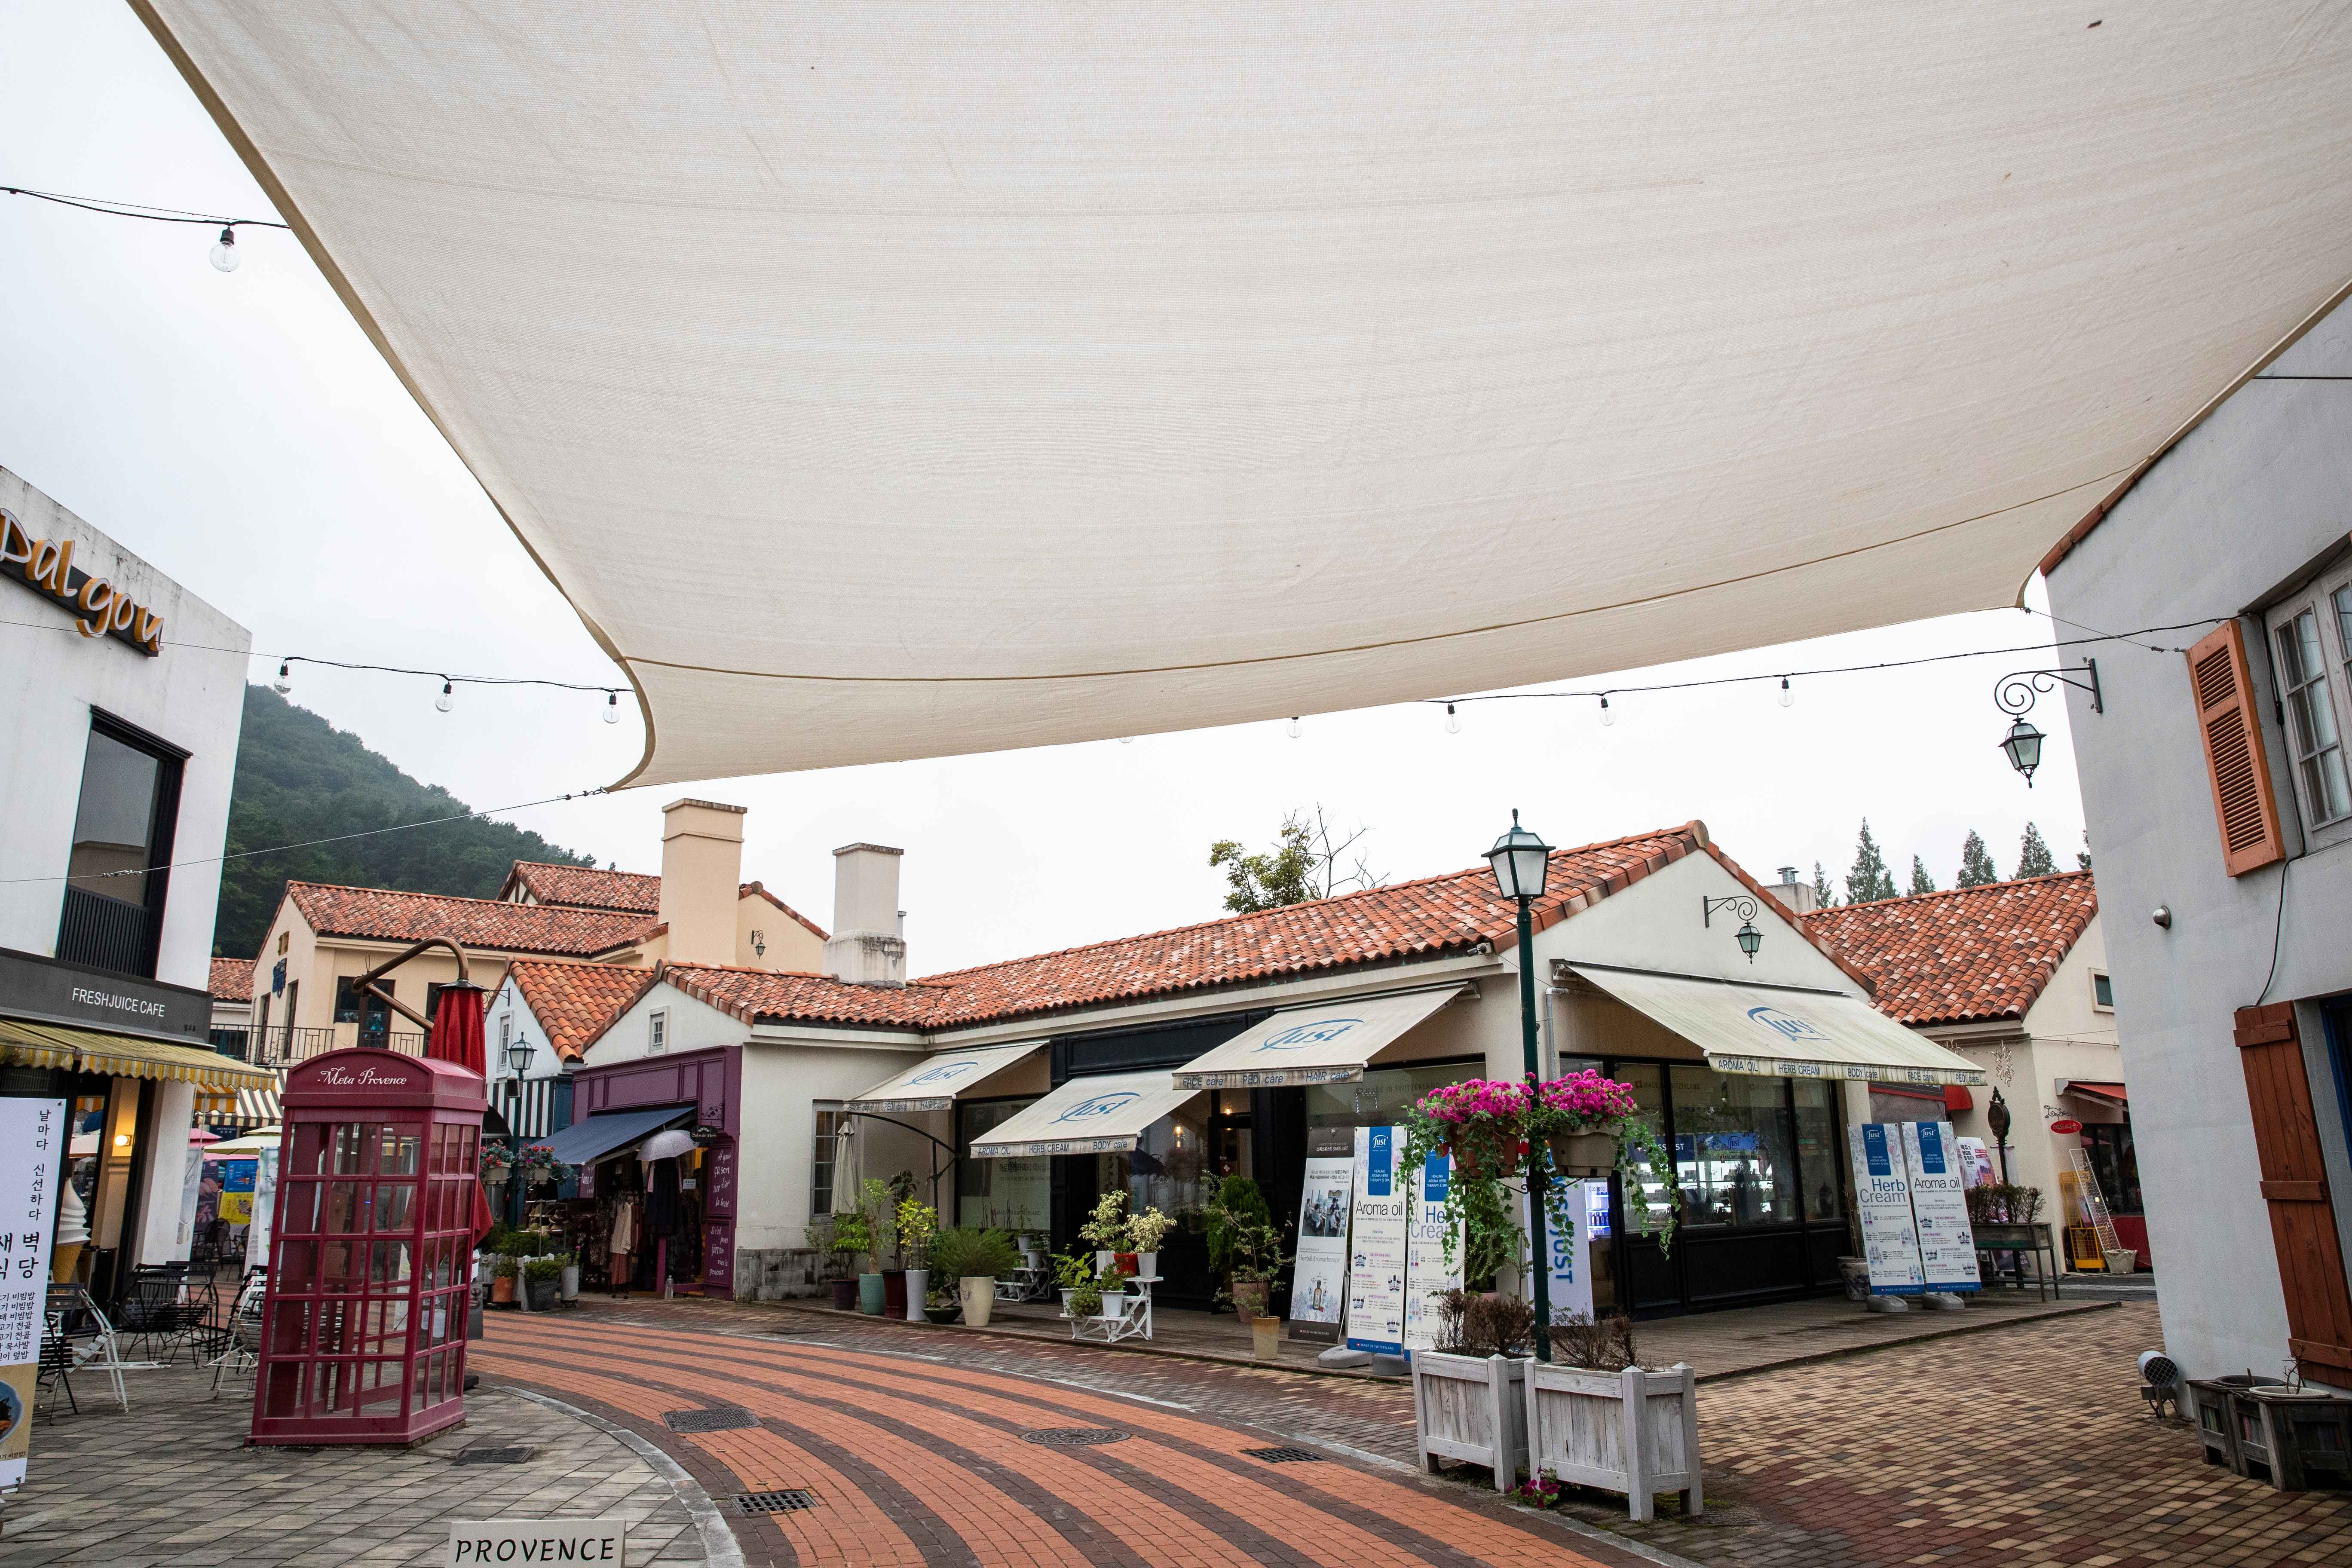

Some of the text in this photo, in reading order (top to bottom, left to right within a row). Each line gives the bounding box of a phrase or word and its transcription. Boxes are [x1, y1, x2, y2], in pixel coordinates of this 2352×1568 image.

[140, 1001, 165, 1017] CAFE
[1748, 1007, 1831, 1041] Just
[1250, 1019, 1365, 1053] Just
[317, 1067, 407, 1085] Meta Provence
[900, 1062, 978, 1086] Just
[1718, 1060, 1744, 1071] AROMA
[1747, 1061, 1758, 1072] OIL
[1779, 1063, 1796, 1074] HERB
[1798, 1065, 1820, 1075] CREAM
[1847, 1068, 1863, 1078] BODY
[1865, 1070, 1878, 1078] care
[1908, 1071, 1921, 1081] FACE
[1923, 1073, 1934, 1081] care
[1956, 1074, 1967, 1082] PEDI
[1182, 1072, 1350, 1087] FACE care PEDI care HAIR care
[921, 1101, 933, 1109] HAIR
[1047, 1092, 1141, 1124] Just
[1866, 1129, 1881, 1140] Just
[1921, 1128, 1936, 1138] Just
[978, 1140, 1127, 1155] AROMA OIL HERB CREAM BODY care
[1372, 1135, 1388, 1148] Just
[1728, 1136, 1741, 1149] Just
[28, 1109, 52, 1221] 날마다 신선하다
[1871, 1178, 1905, 1192] Herb
[1914, 1177, 1960, 1189] Aroma oil
[1860, 1189, 1906, 1203] Cream
[1355, 1200, 1403, 1216] Aroma oil
[1426, 1206, 1461, 1224] He
[1549, 1229, 1574, 1284] JUST
[12, 1292, 36, 1301] 비빔밥
[11, 1302, 34, 1311] 비빔밥
[10, 1311, 34, 1320] 비빔밥
[16, 1321, 32, 1331] 전골
[15, 1331, 31, 1340] 전골
[5, 1341, 30, 1350] 묵사발
[13, 1351, 29, 1360] 덮밥
[455, 1537, 615, 1563] PROVENCE
